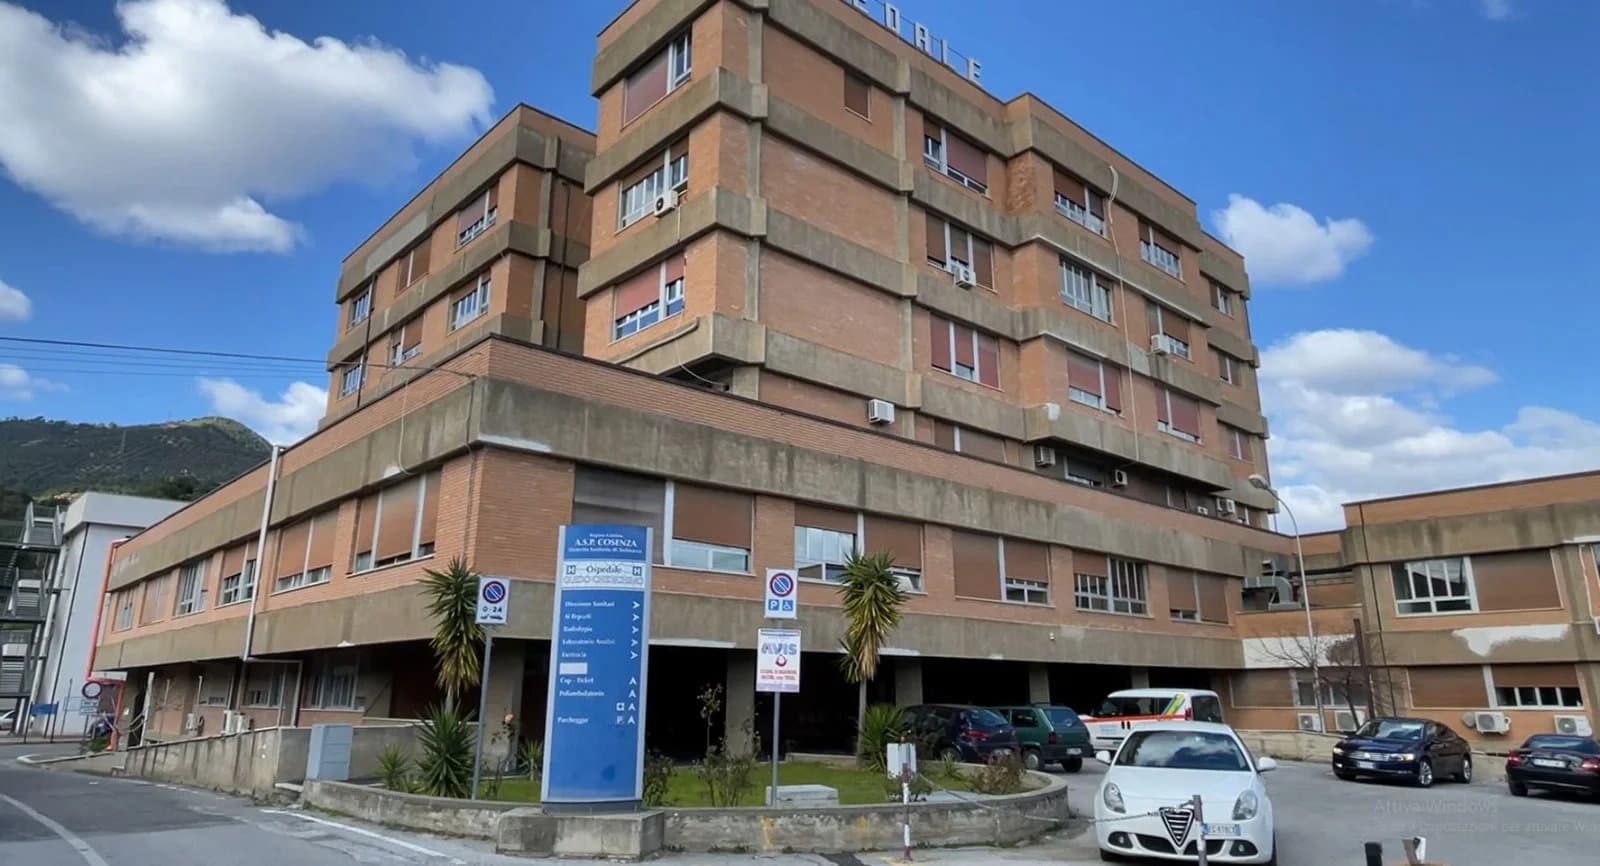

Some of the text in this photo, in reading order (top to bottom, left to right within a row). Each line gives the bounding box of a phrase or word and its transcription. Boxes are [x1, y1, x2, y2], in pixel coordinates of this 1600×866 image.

[597, 538, 637, 548] COSENZA
[586, 565, 622, 574] Ospedale
[770, 600, 778, 610] P
[761, 642, 798, 655] AVIS
